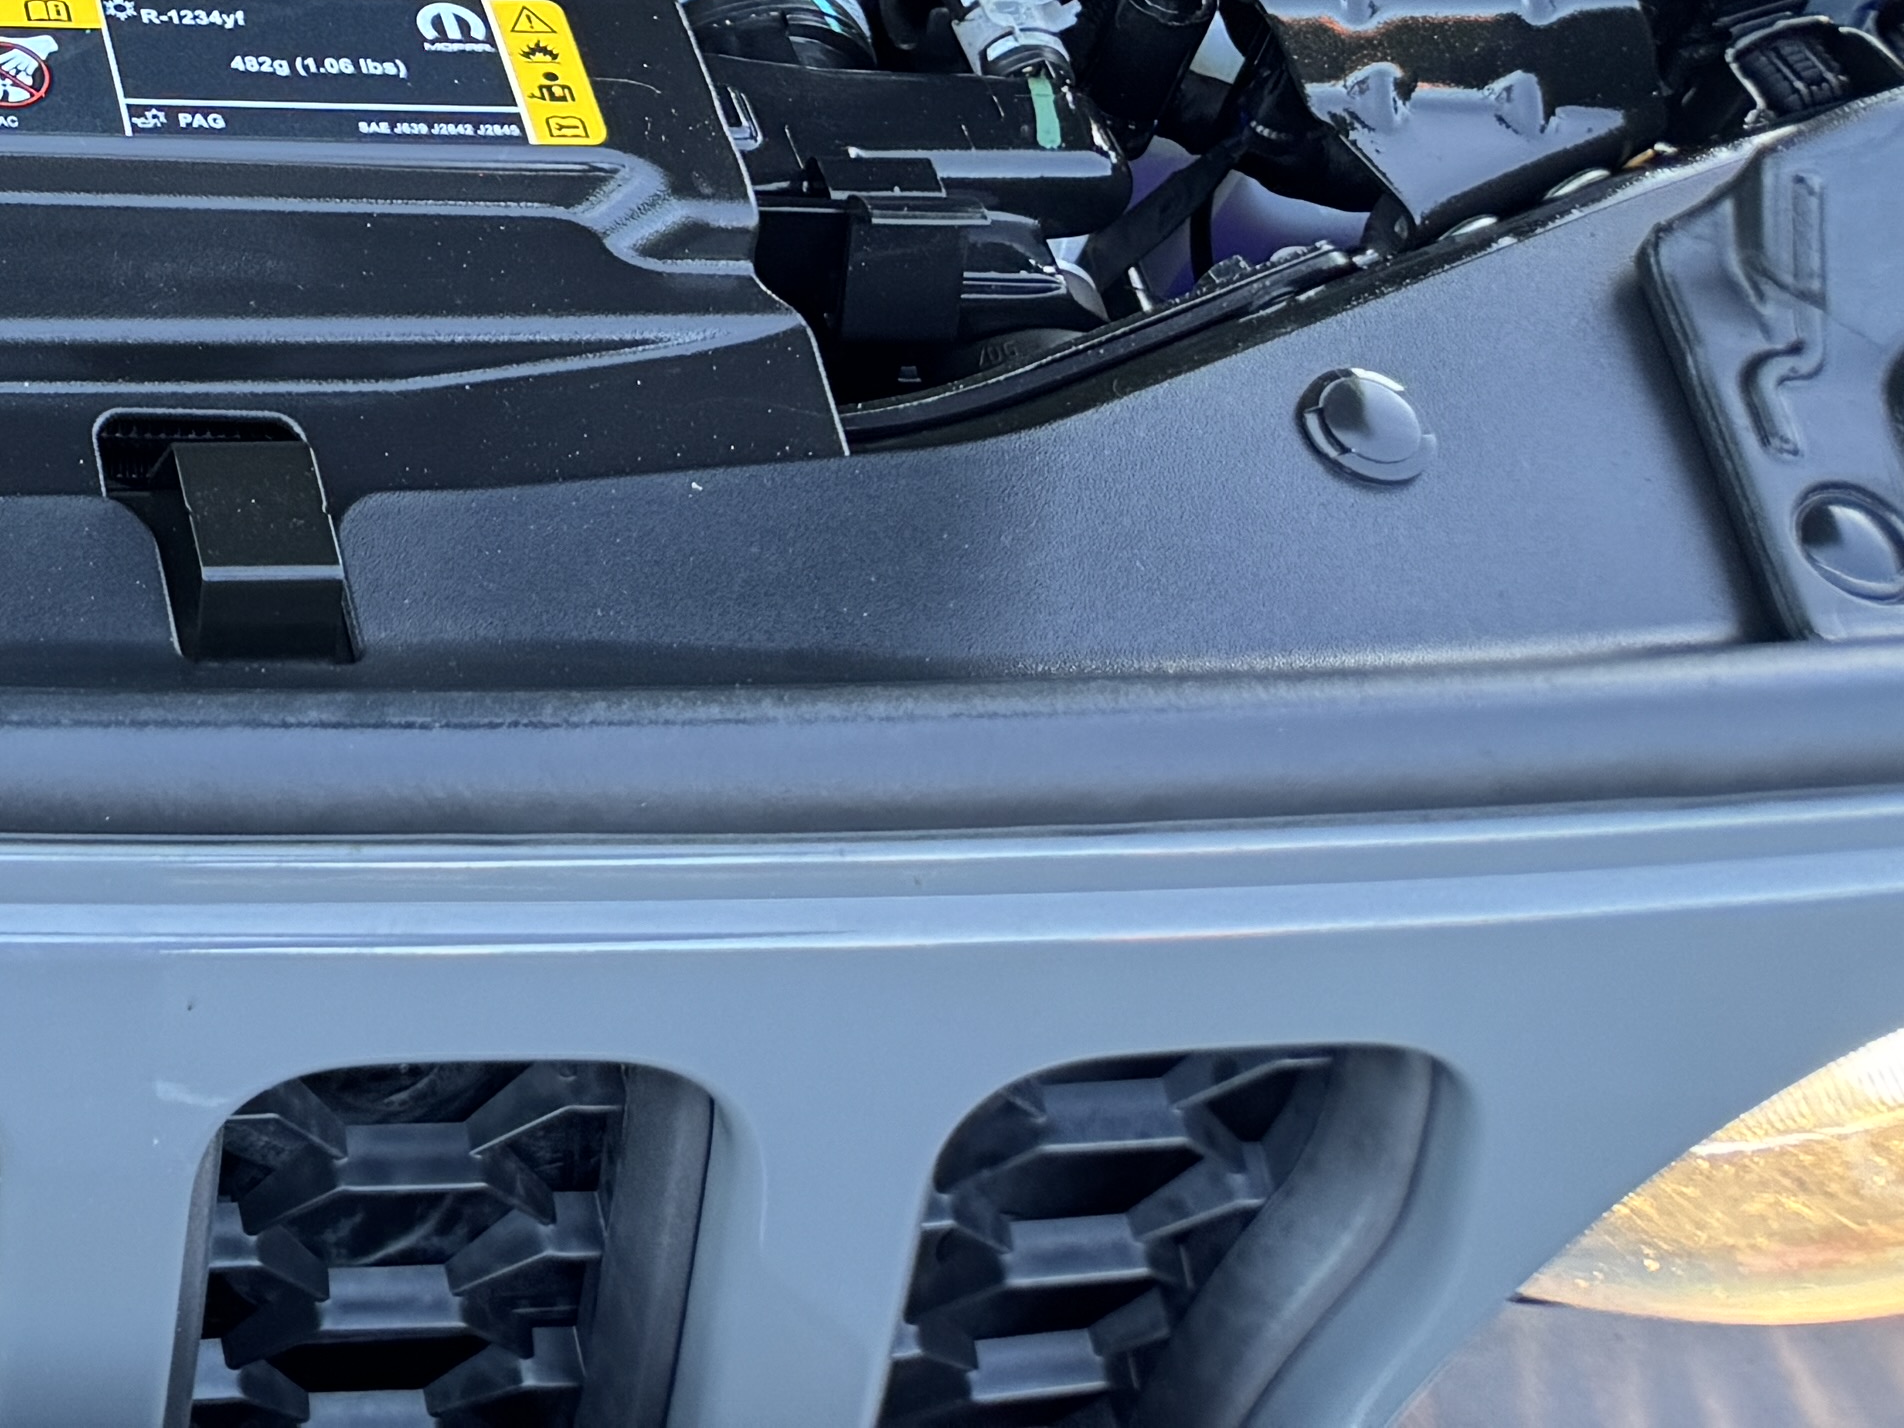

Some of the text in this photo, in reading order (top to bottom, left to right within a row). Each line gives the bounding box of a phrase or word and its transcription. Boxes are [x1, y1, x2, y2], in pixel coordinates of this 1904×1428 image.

[139, 8, 246, 29] R-1234yf
[230, 55, 408, 79] 482g (1.06 lbs)
[178, 112, 227, 130] PAG
